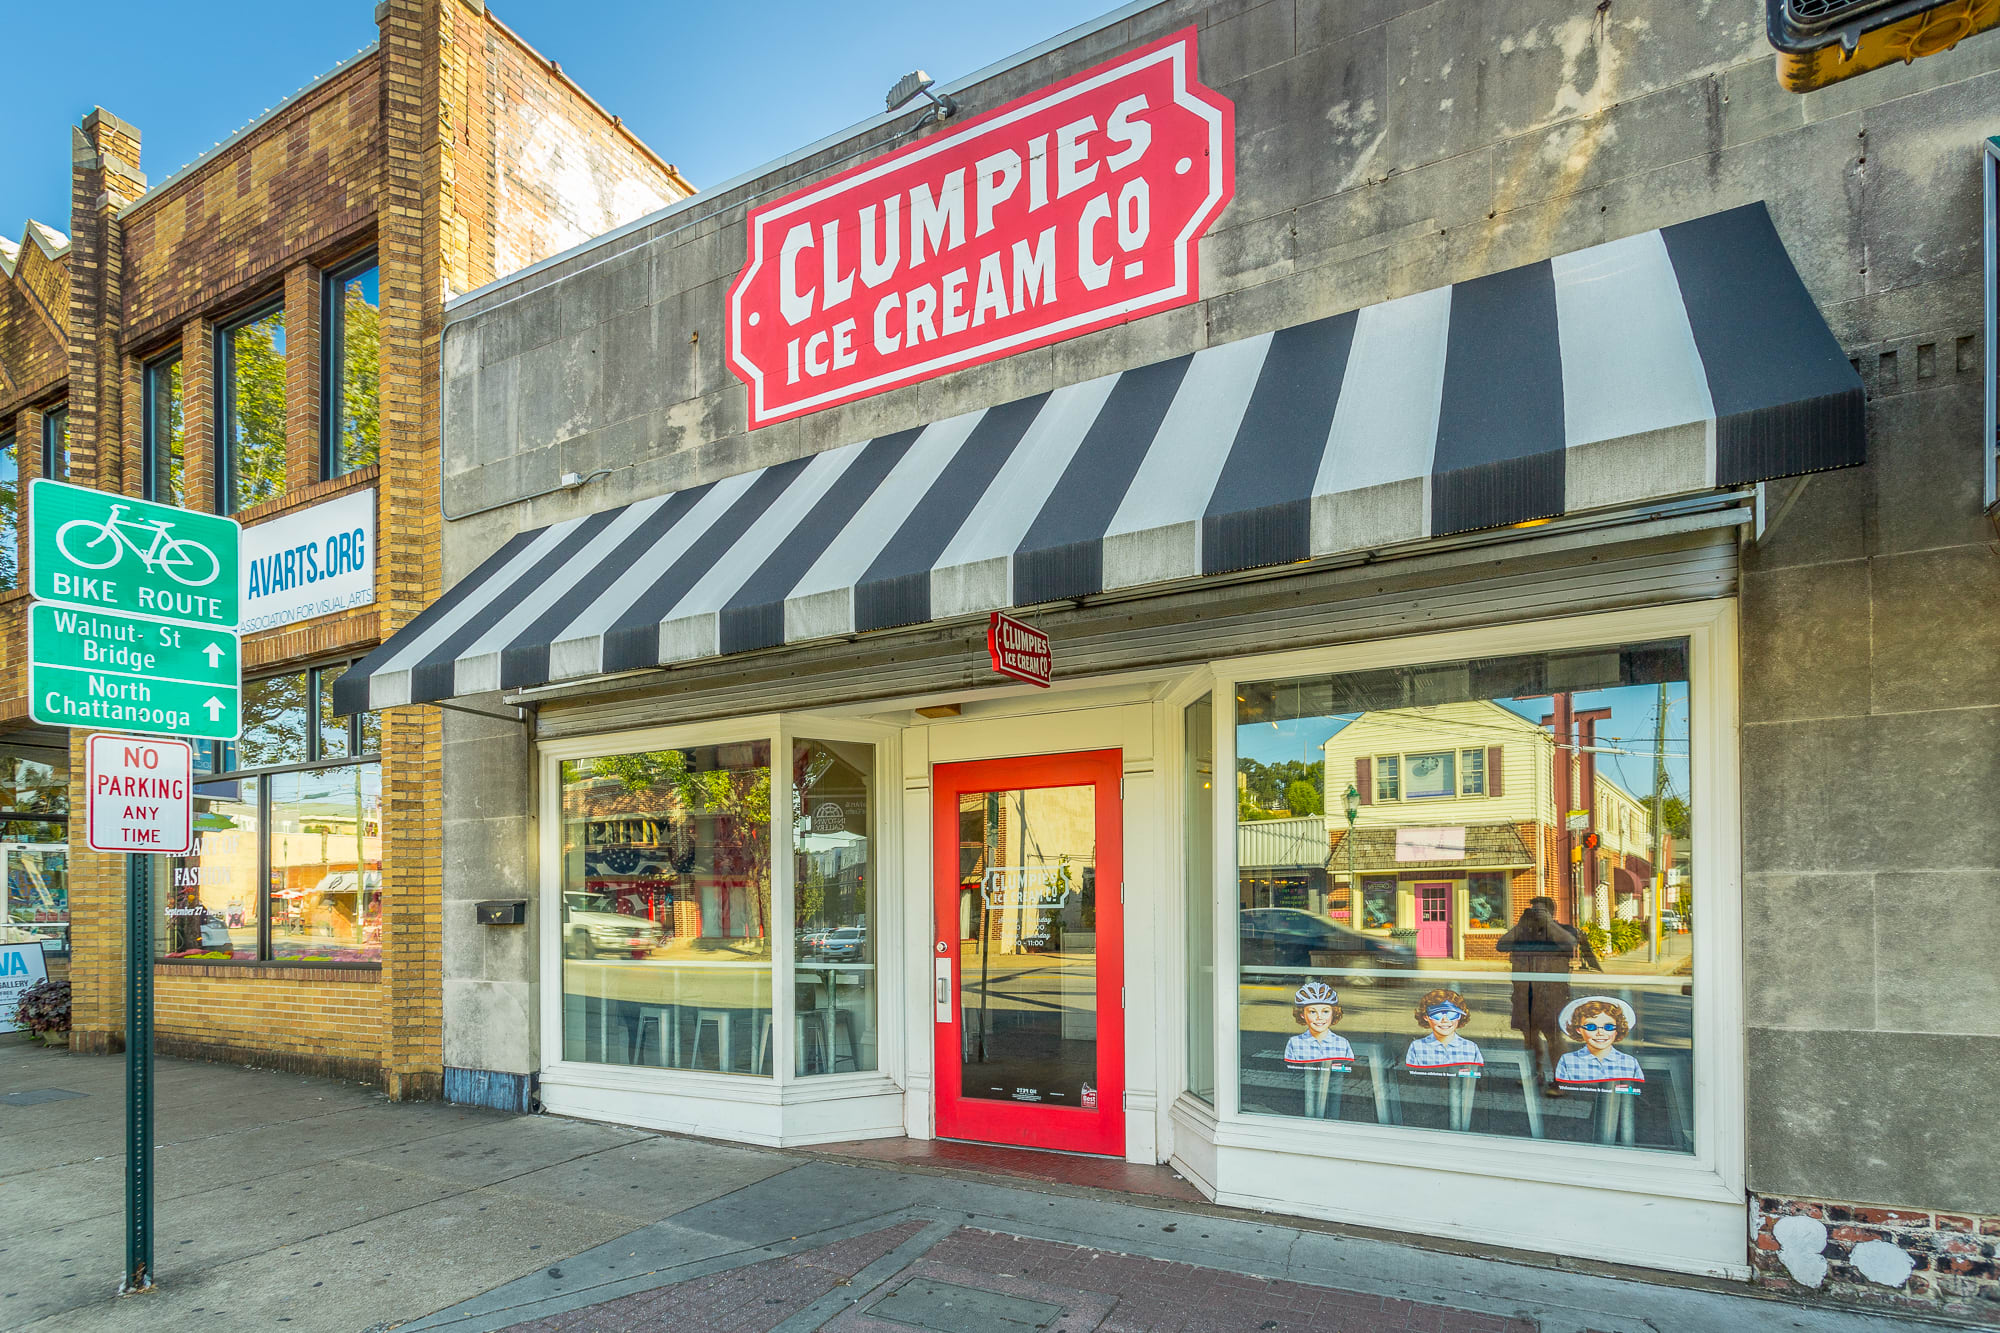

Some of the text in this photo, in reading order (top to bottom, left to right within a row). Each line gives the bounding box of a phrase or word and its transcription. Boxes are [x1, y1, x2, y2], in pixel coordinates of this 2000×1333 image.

[779, 94, 1152, 326] CLUMPIES
[786, 317, 857, 385] ICE
[873, 226, 1058, 356] CREAM
[248, 528, 365, 600] AVARTS.ORG
[53, 572, 223, 619] BIKE ROUTE
[240, 588, 373, 633] ASSOCIATION FOR VISUAL ARTS
[54, 611, 181, 649] Walnut St
[1003, 621, 1047, 654] CLUMPIES
[83, 639, 156, 672] Bridge
[1005, 651, 1017, 667] ICE
[1017, 653, 1040, 675] CREAM
[88, 675, 151, 702] North
[45, 691, 190, 730] Chattanooga
[124, 746, 159, 769] NO
[98, 774, 183, 800] PARKING
[122, 805, 160, 821] ANY
[121, 827, 161, 843] TIME
[191, 834, 240, 857] ART OF
[174, 865, 232, 886] FASHION
[992, 872, 1058, 892] CLUMPIES
[993, 892, 1008, 904] ICE
[1010, 889, 1044, 903] CREAM
